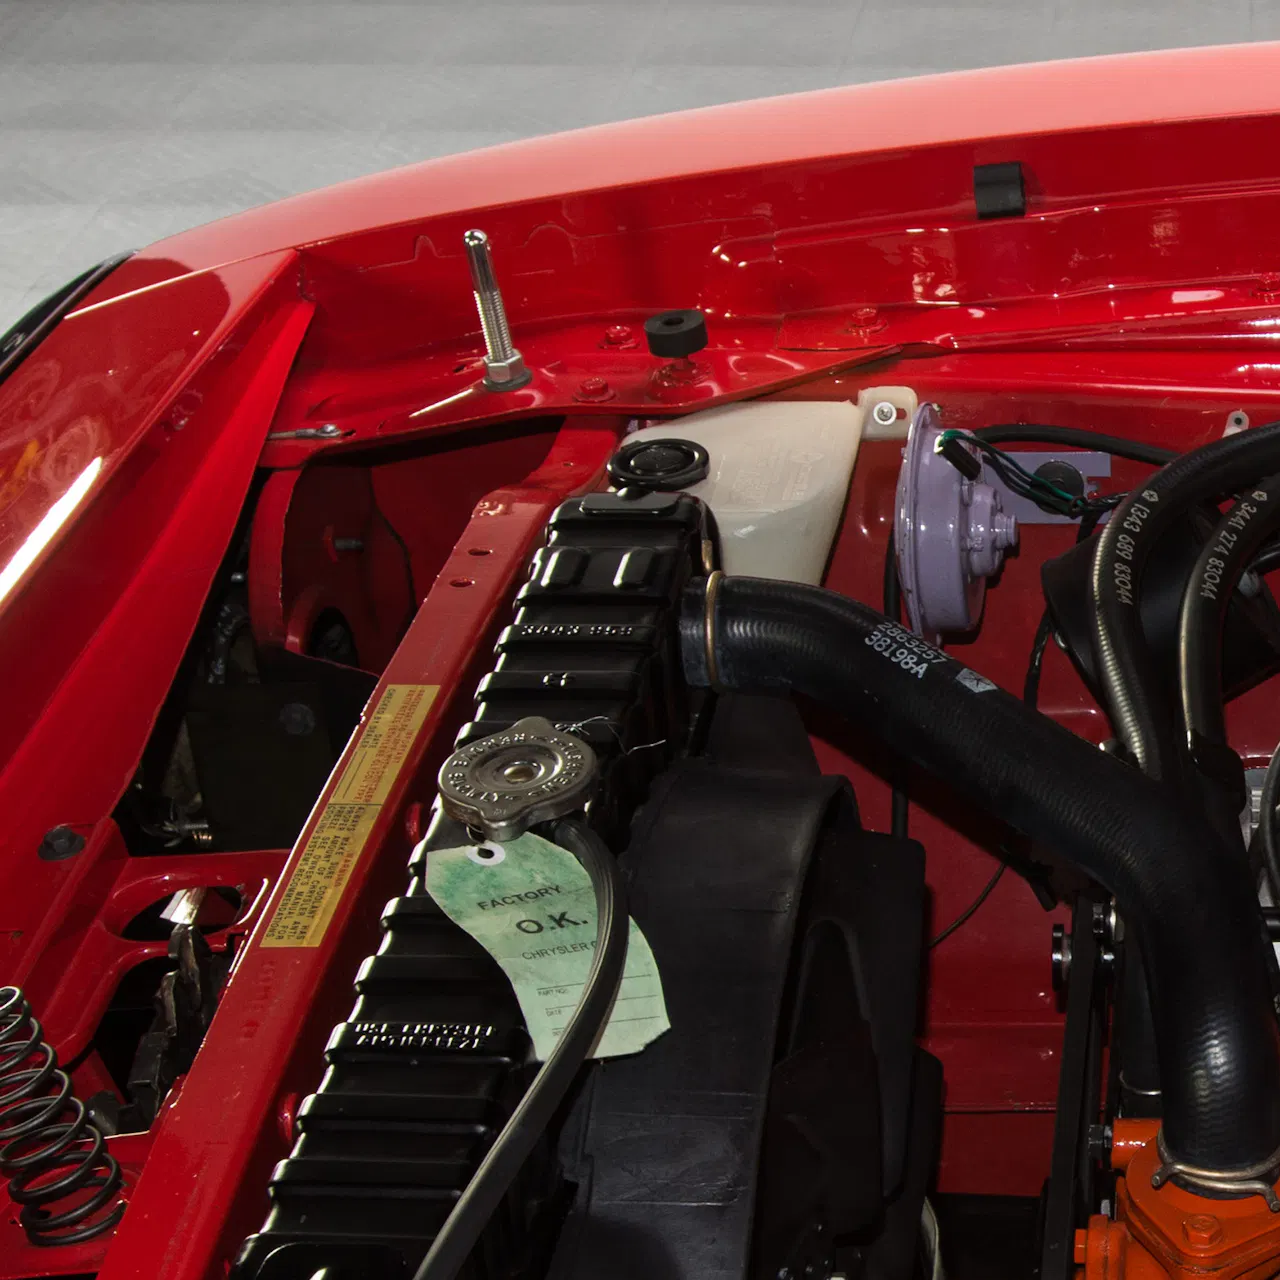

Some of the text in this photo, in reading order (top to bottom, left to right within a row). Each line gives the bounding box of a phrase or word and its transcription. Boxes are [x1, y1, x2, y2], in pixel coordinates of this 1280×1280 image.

[1113, 503, 1150, 605] 1343 689 83044
[1200, 502, 1257, 600] 3441 274 83044
[864, 631, 929, 678] 38198-A
[878, 621, 947, 664] 2863257
[306, 885, 327, 918] COOLANT
[477, 885, 561, 910] FACTORY
[516, 911, 588, 934] O.K.
[522, 942, 590, 960] CHRYSLER
